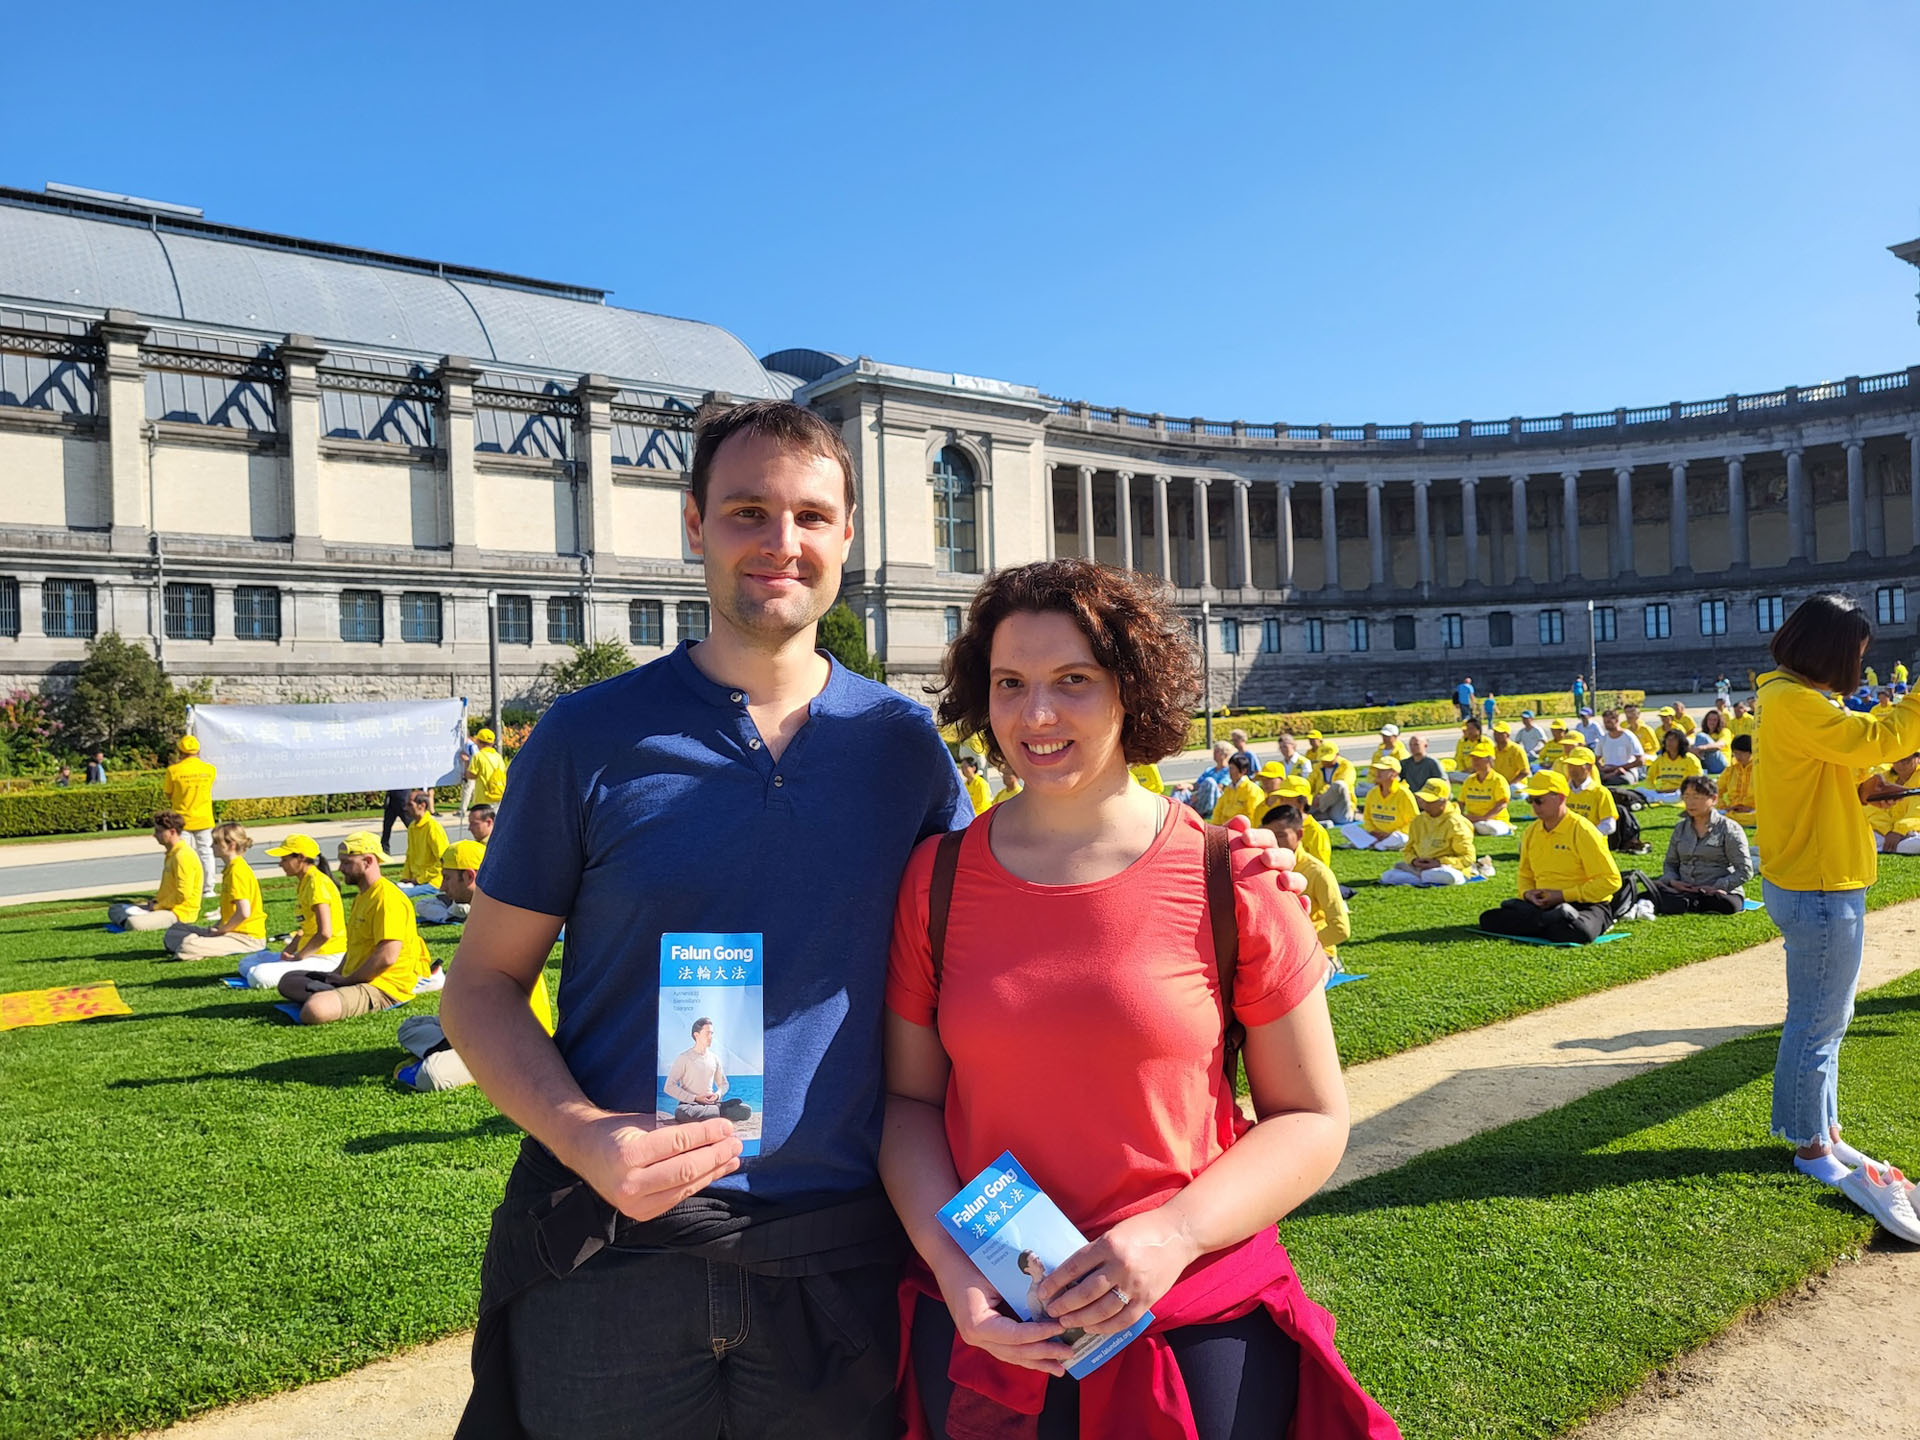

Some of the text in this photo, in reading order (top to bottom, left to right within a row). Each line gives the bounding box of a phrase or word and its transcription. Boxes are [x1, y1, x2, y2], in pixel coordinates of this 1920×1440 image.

[671, 945, 754, 963] Falun Gong
[677, 965, 747, 981] 法輪大法
[952, 1167, 1018, 1229] Falun Gong
[972, 1187, 1025, 1240] 法輪大法
